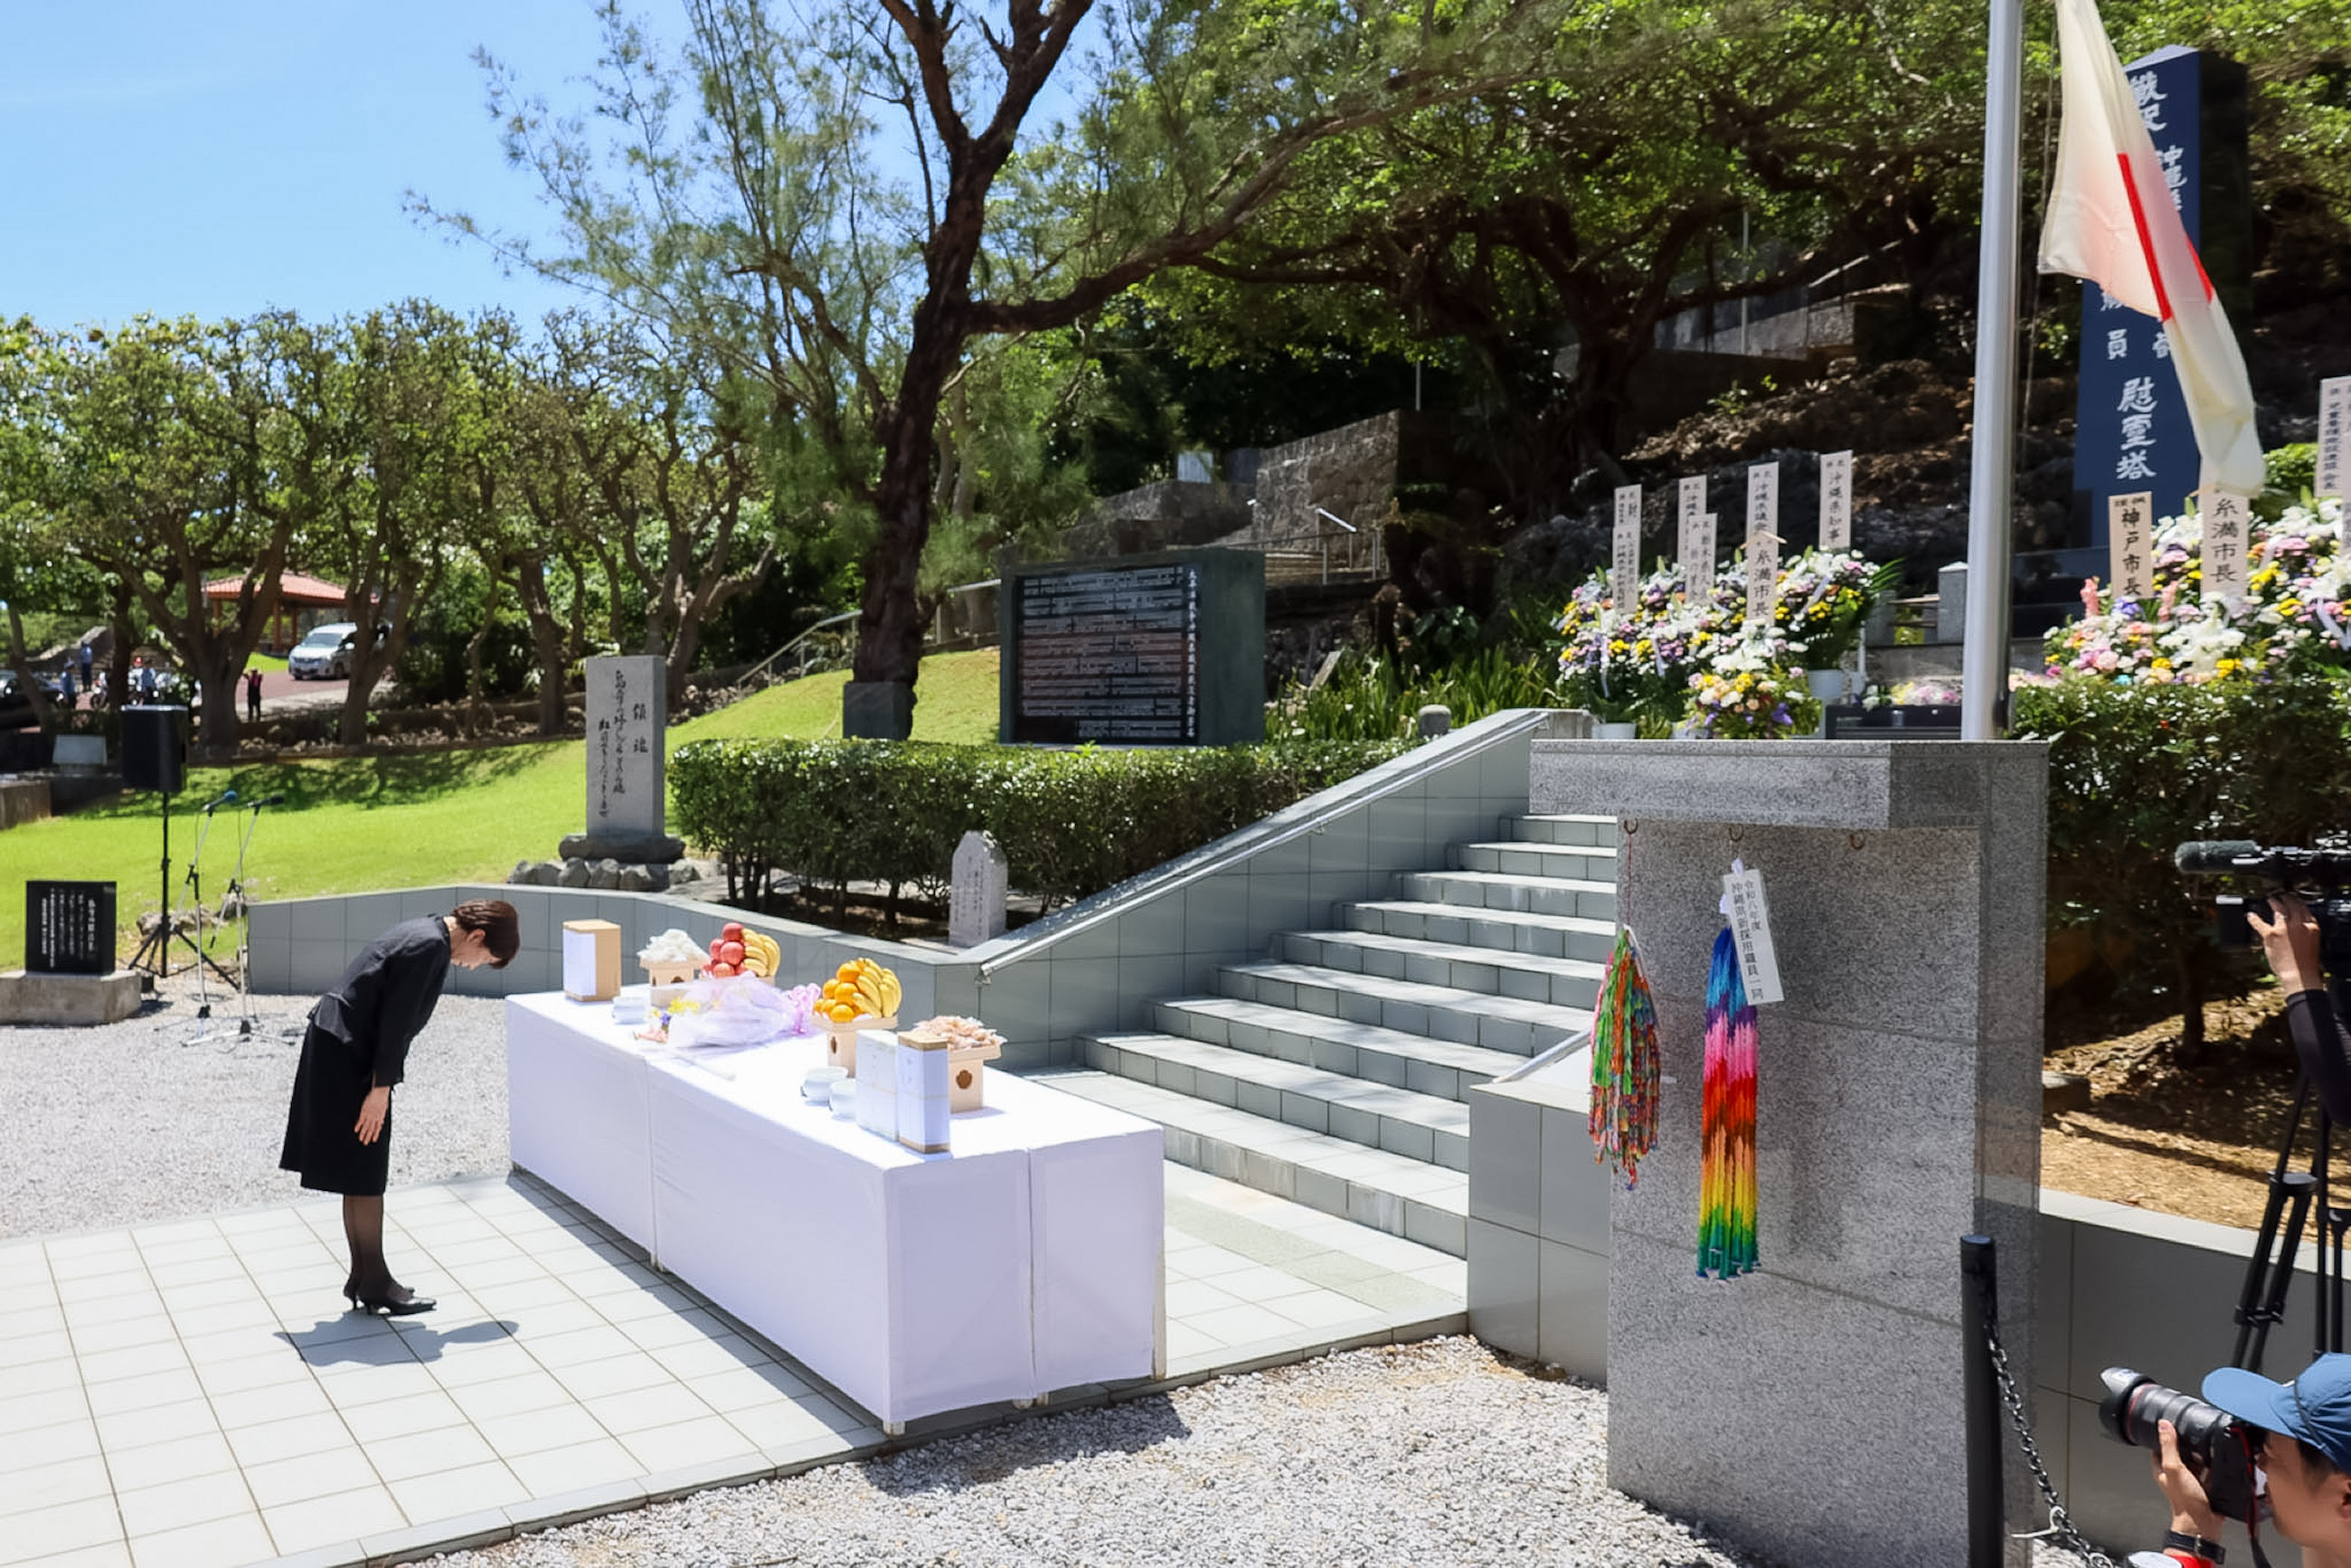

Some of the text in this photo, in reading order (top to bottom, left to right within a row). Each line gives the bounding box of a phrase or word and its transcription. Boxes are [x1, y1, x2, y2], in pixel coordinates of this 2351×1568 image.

[2121, 507, 2141, 597] 神戸市長
[2209, 498, 2240, 582] 糸満市長
[1752, 549, 1772, 616] 糸満市長
